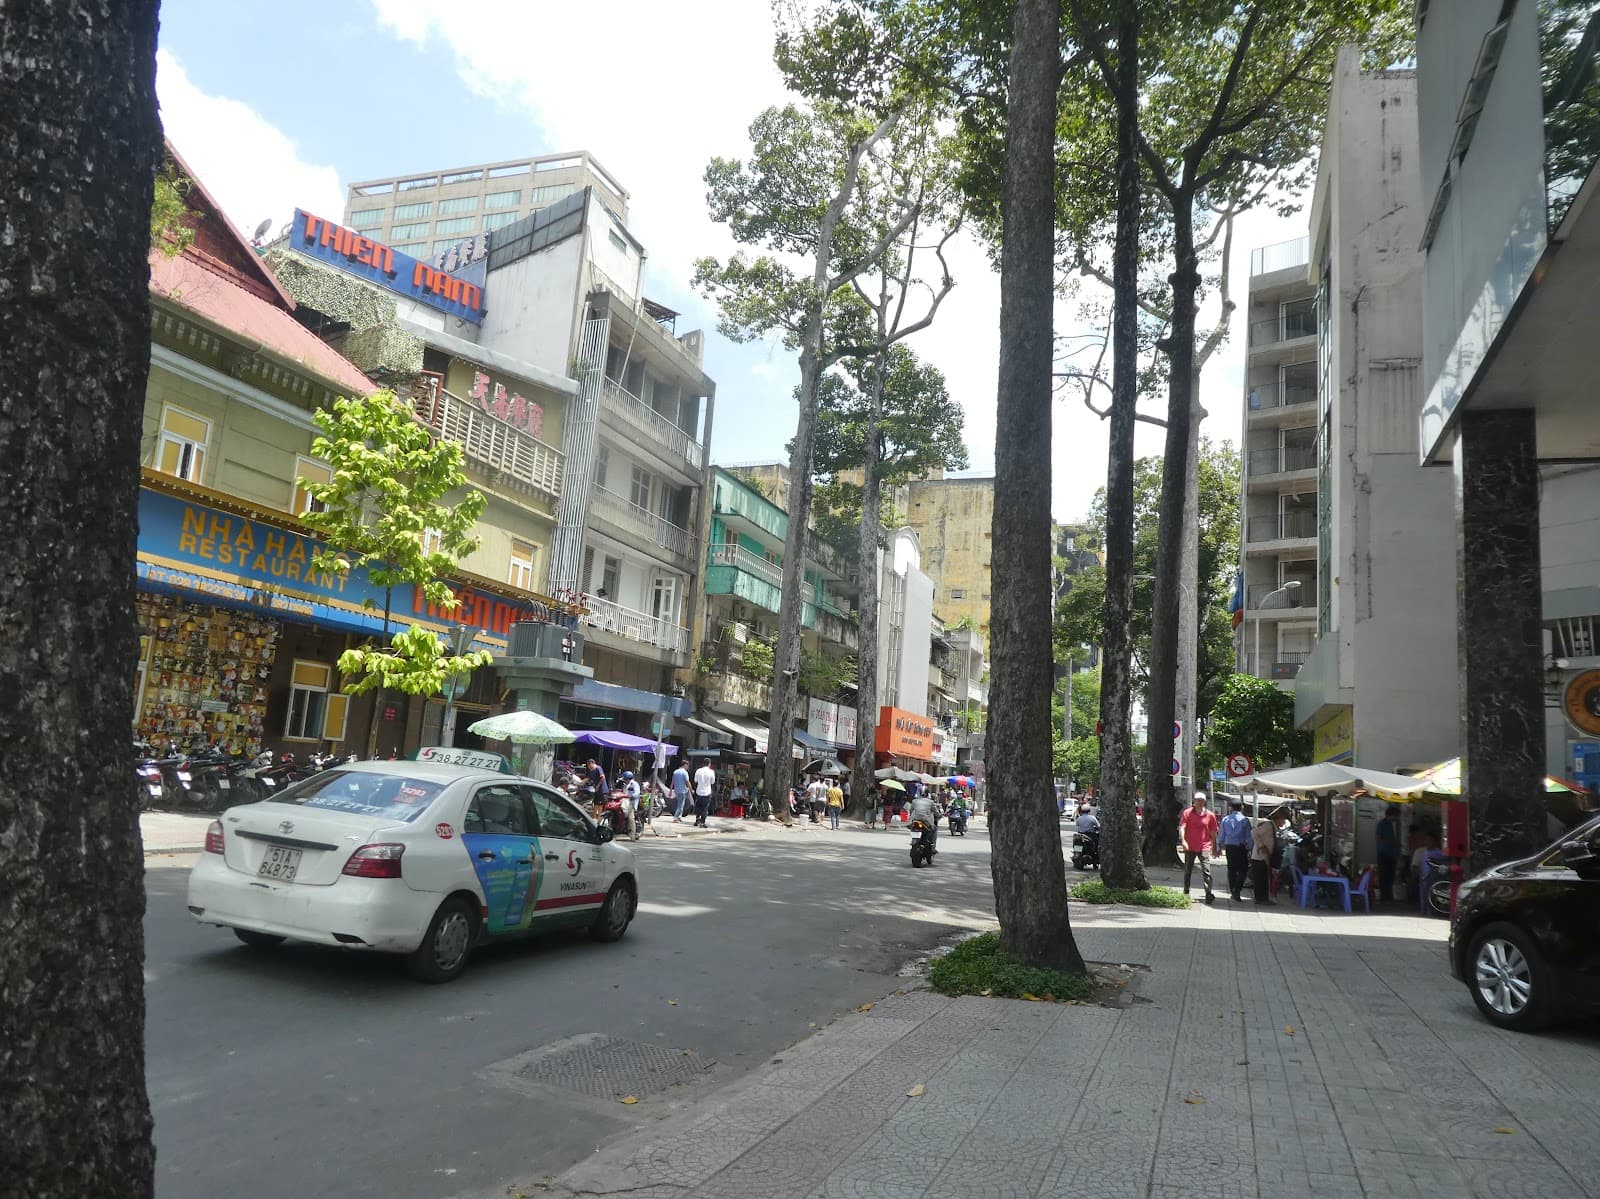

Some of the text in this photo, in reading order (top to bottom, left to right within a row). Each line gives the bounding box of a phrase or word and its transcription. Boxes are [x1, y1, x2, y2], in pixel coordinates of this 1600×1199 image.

[413, 260, 481, 311] NAM
[182, 507, 255, 550] NHÀ
[179, 532, 349, 592] RESTAURANT
[470, 757, 484, 767] 27
[485, 759, 500, 769] 27
[259, 862, 296, 879] 64873
[271, 849, 292, 863] 51A
